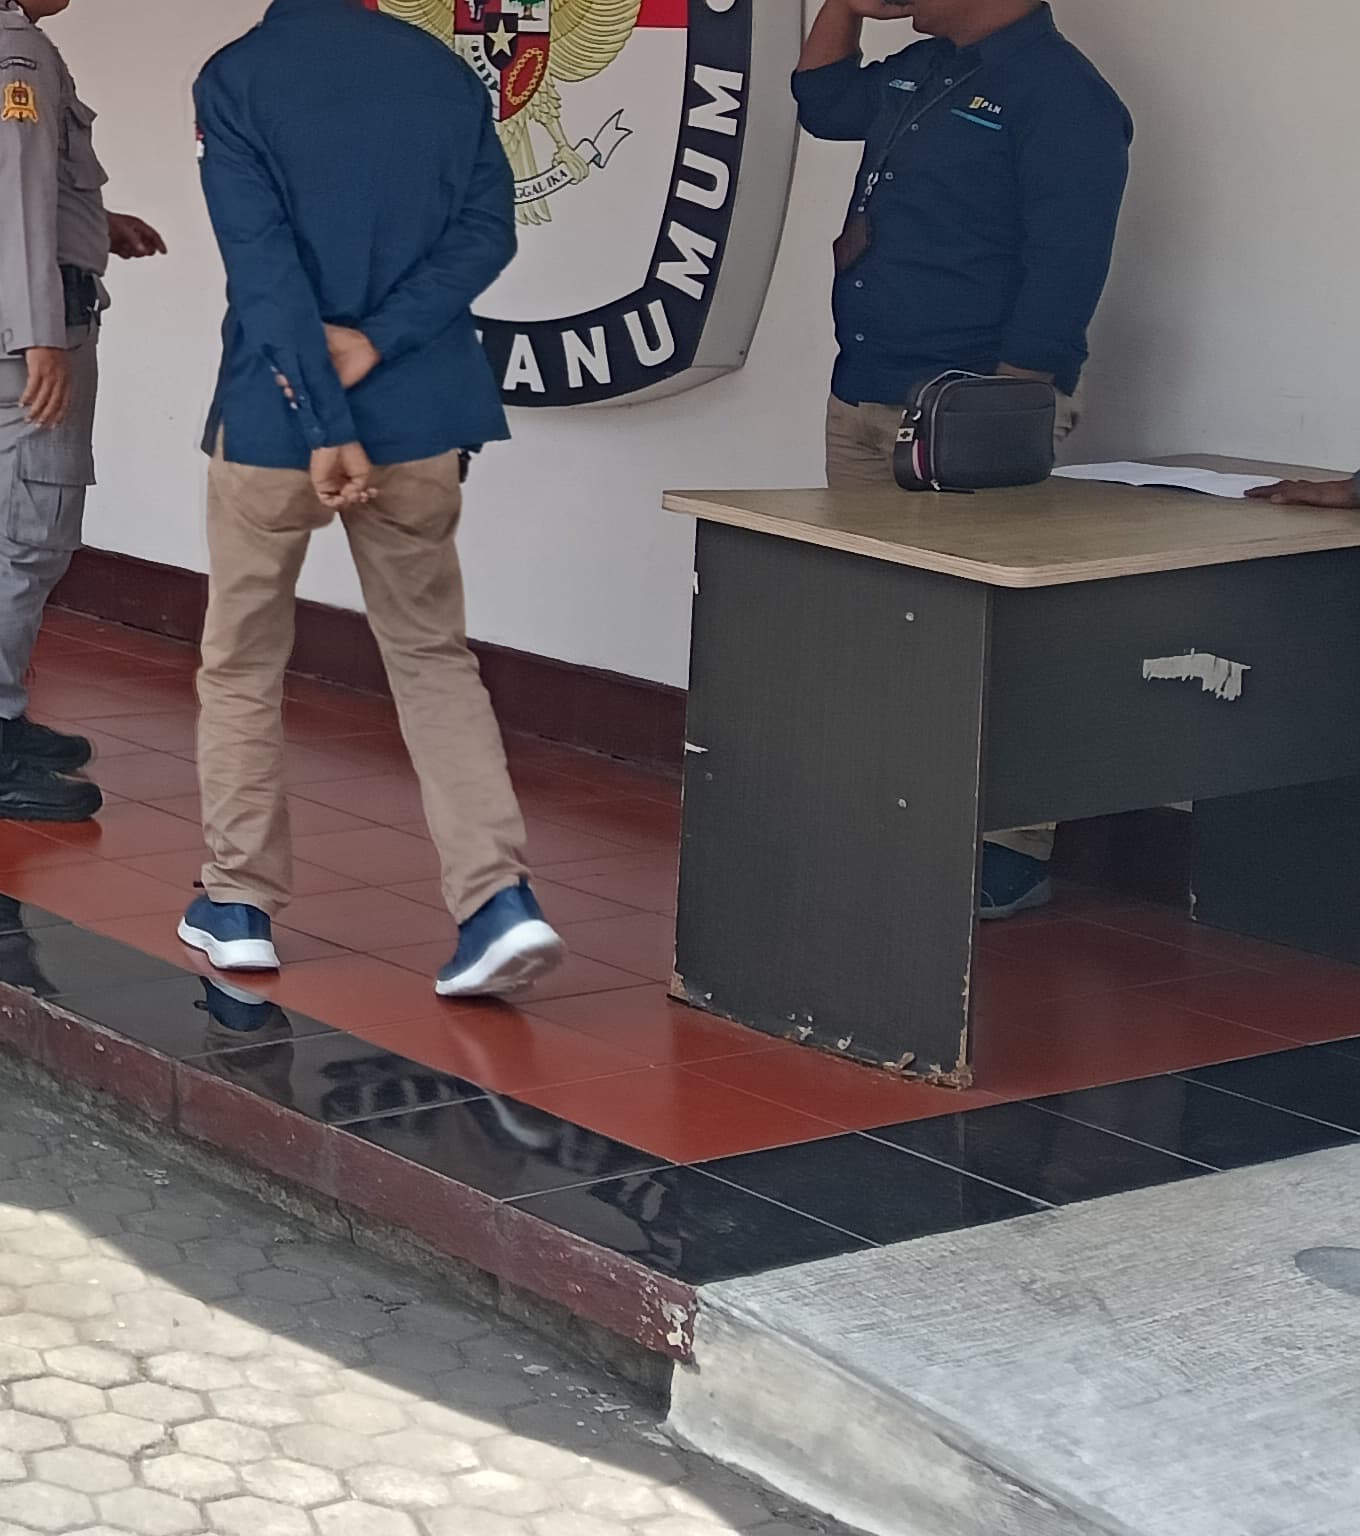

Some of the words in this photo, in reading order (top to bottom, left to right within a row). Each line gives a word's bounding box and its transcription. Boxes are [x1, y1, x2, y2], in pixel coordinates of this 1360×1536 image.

[981, 101, 1002, 114] PLN
[514, 180, 547, 199] GGAL
[546, 169, 568, 187] IKA
